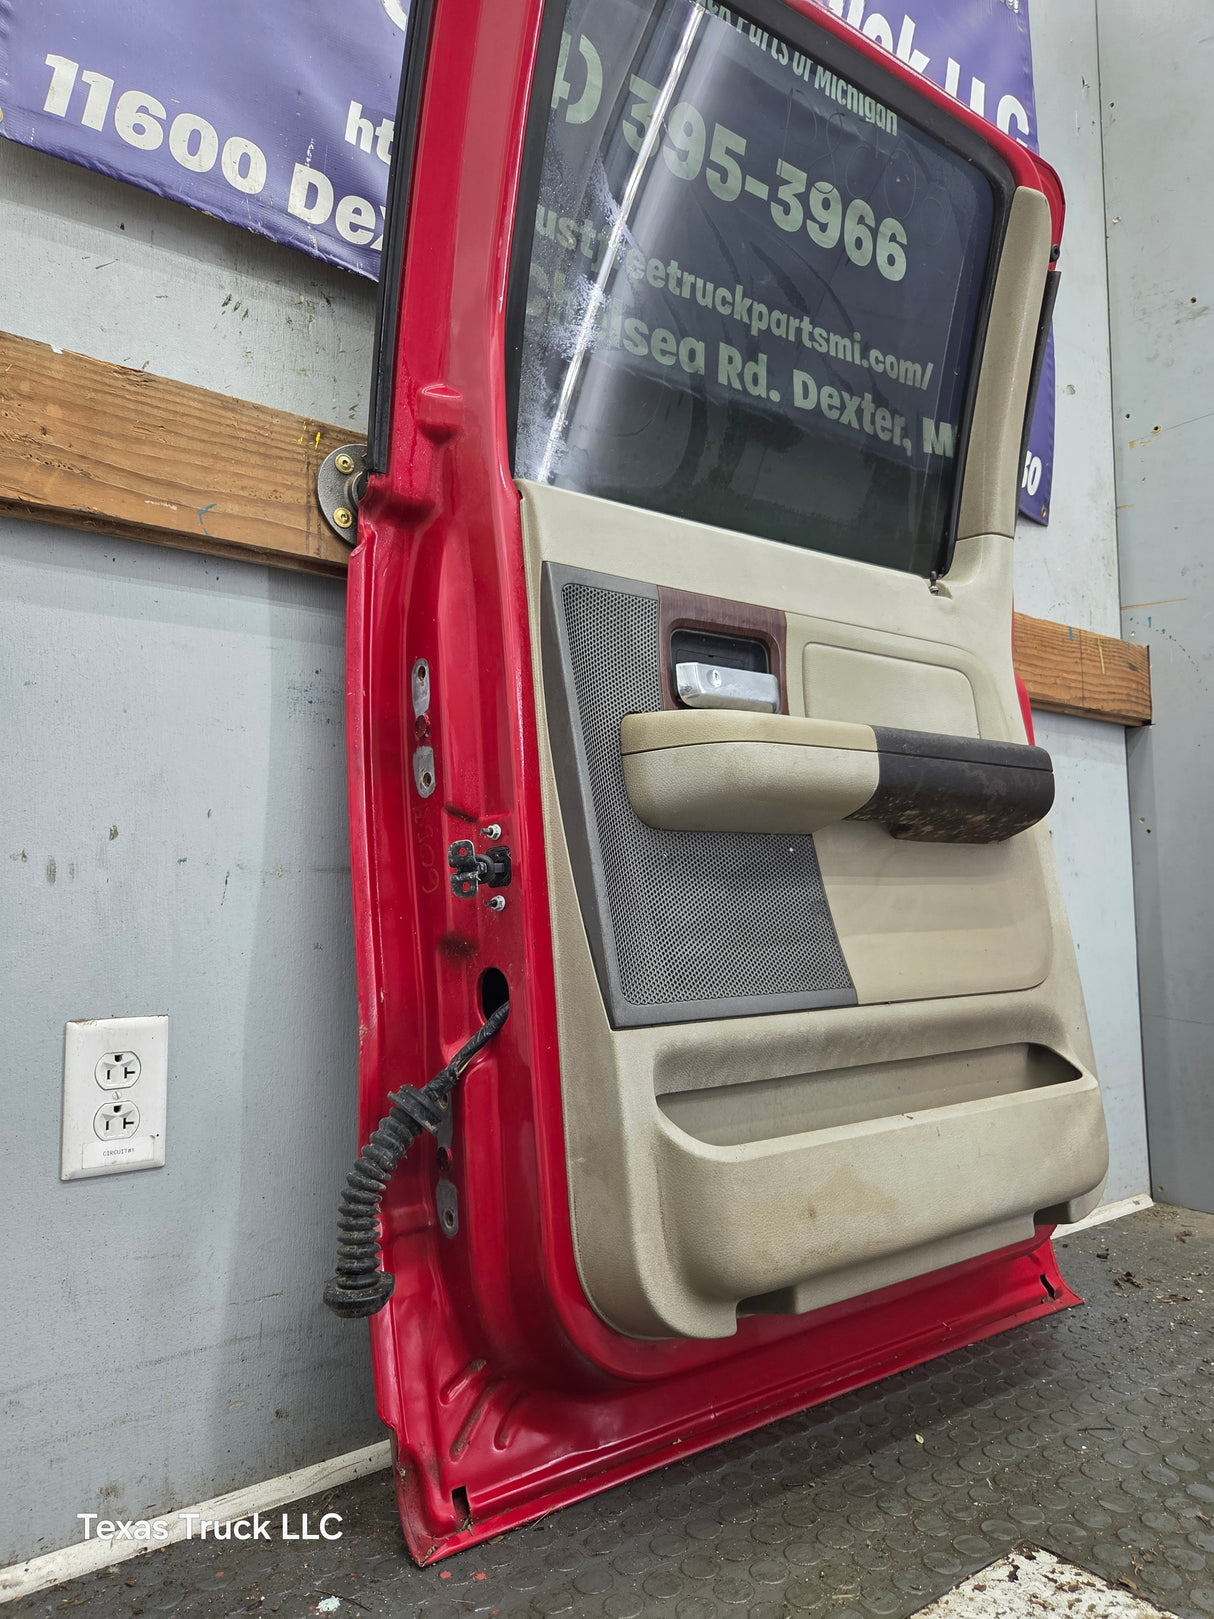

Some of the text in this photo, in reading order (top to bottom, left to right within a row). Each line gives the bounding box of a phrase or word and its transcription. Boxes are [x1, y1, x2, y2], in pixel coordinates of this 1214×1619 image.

[43, 53, 267, 195] 11600
[717, 342, 781, 402] Rd.
[793, 369, 912, 456] Dexter,
[622, 73, 908, 282] 395-3966
